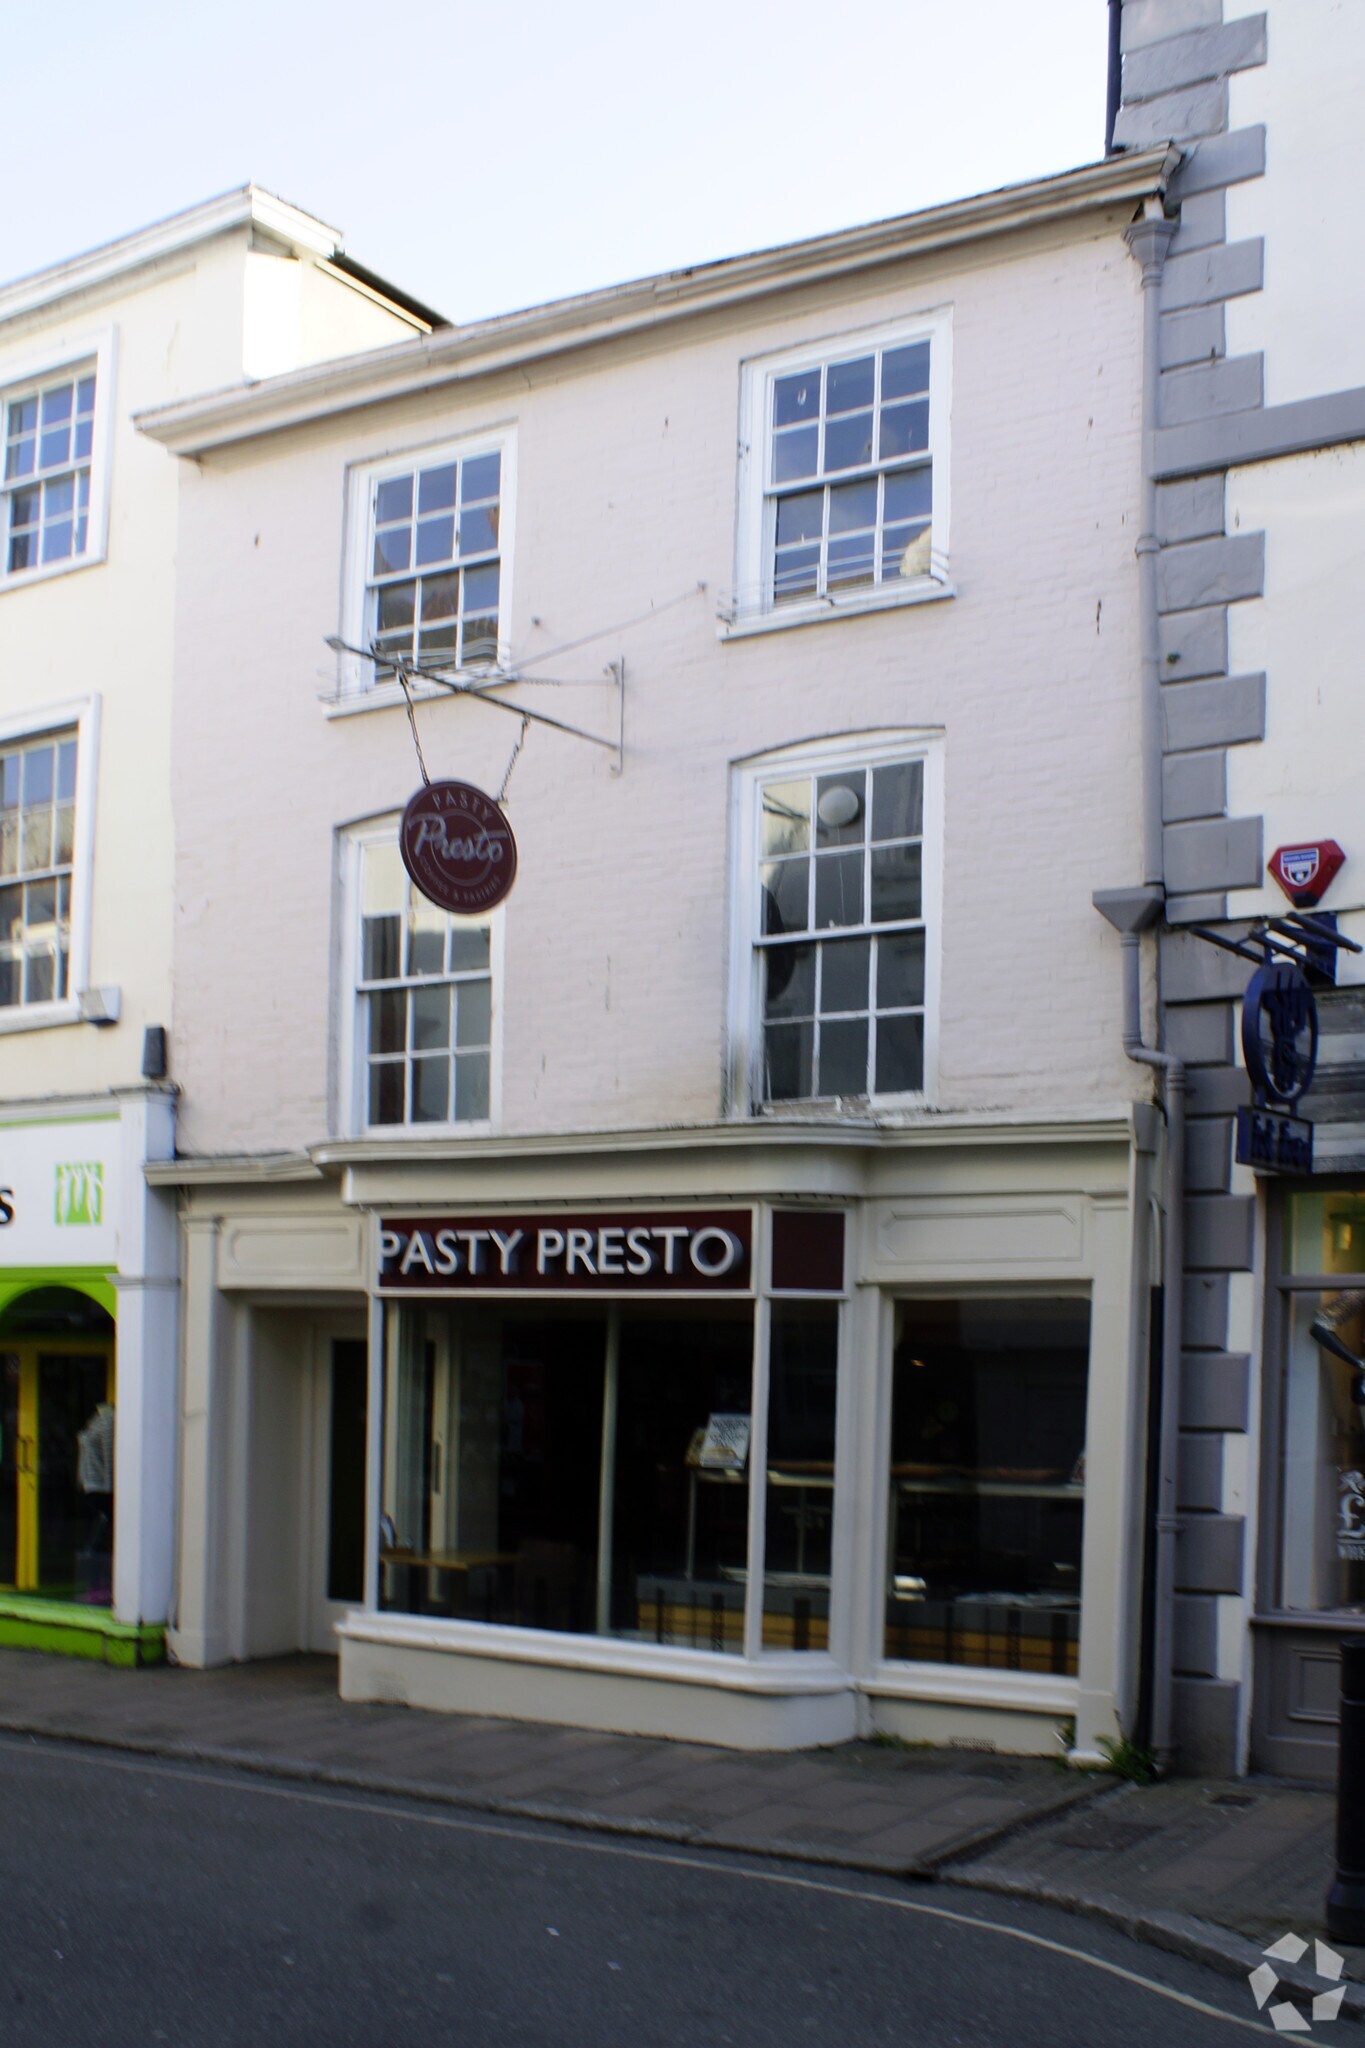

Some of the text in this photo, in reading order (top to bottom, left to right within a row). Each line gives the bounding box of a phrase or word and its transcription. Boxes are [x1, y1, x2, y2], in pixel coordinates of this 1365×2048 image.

[431, 789, 493, 821] PASTY
[407, 813, 509, 863] Presto
[379, 1226, 737, 1277] PASTY PRESTO
